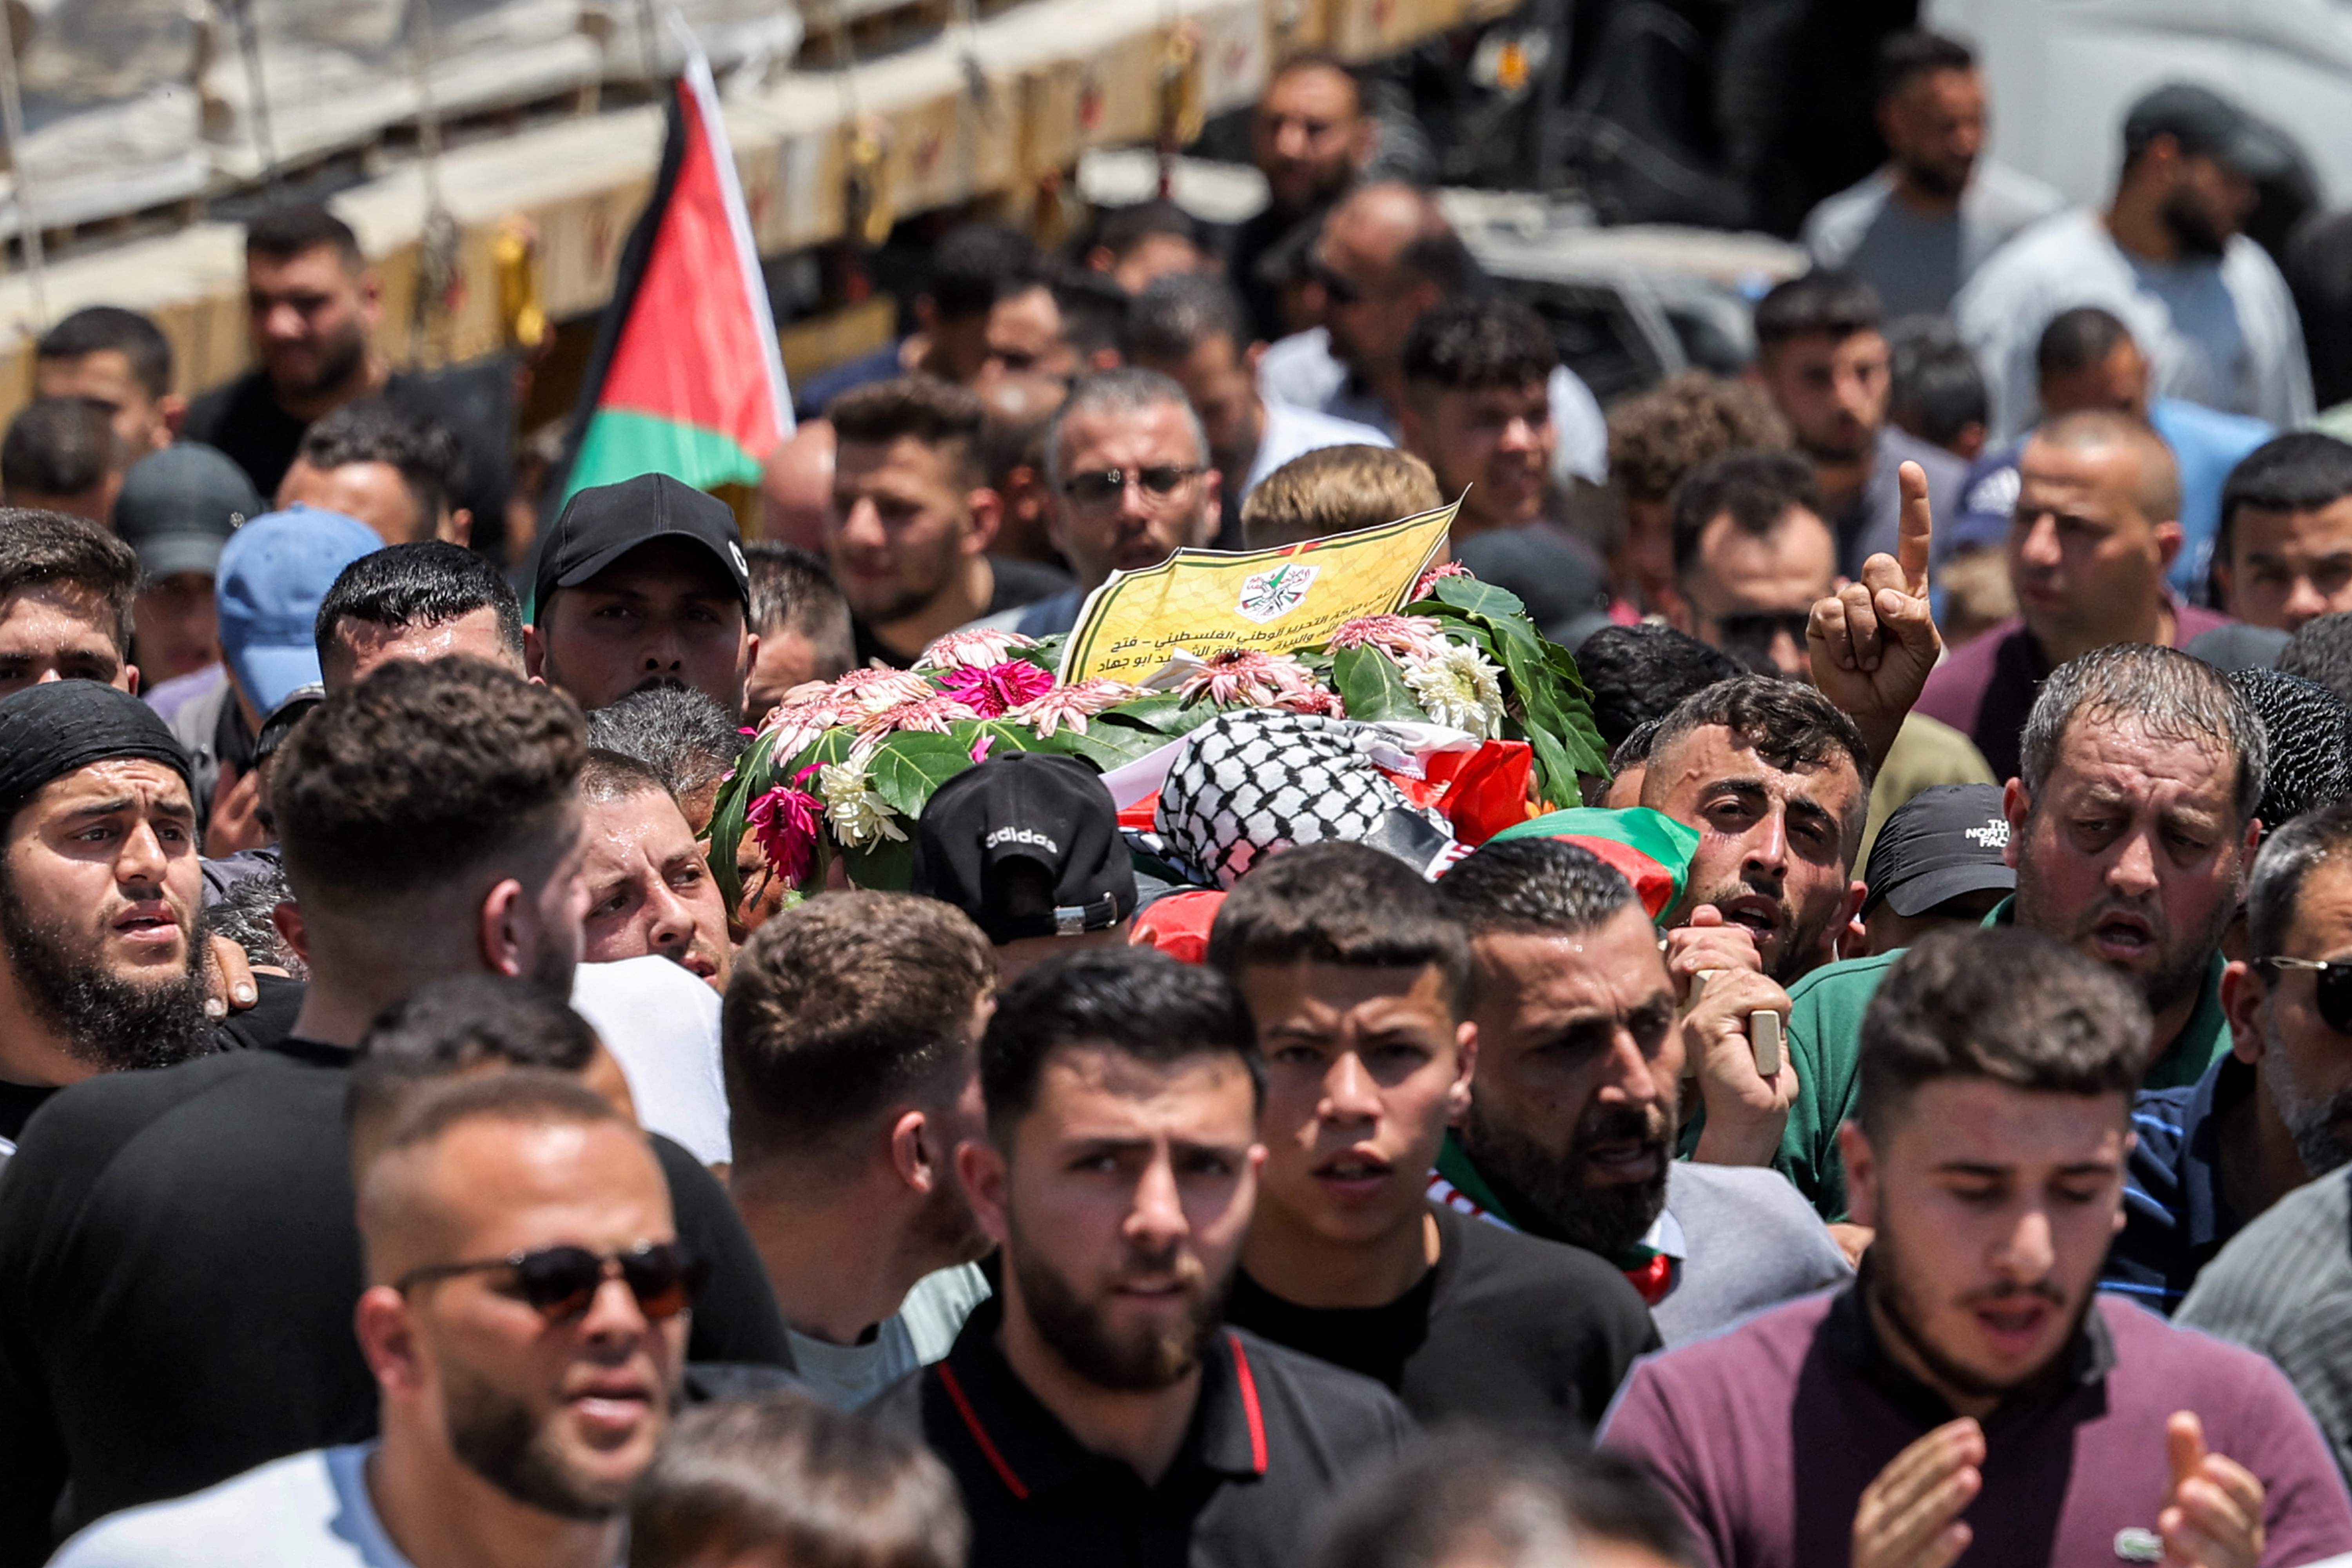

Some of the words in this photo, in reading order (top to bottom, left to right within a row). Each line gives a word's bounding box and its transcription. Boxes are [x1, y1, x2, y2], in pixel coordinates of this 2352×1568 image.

[1285, 614, 1328, 637] التحرير
[1154, 630, 1235, 650] الفلسطيني
[1236, 627, 1285, 644] الوطني
[1111, 636, 1138, 653] فتح
[1097, 657, 1130, 672] جهاد
[1133, 653, 1153, 668] ابو
[1987, 819, 2009, 829] TH
[985, 826, 1058, 853] adidas
[1965, 828, 2010, 839] NORT
[1980, 836, 2008, 848] FAC
